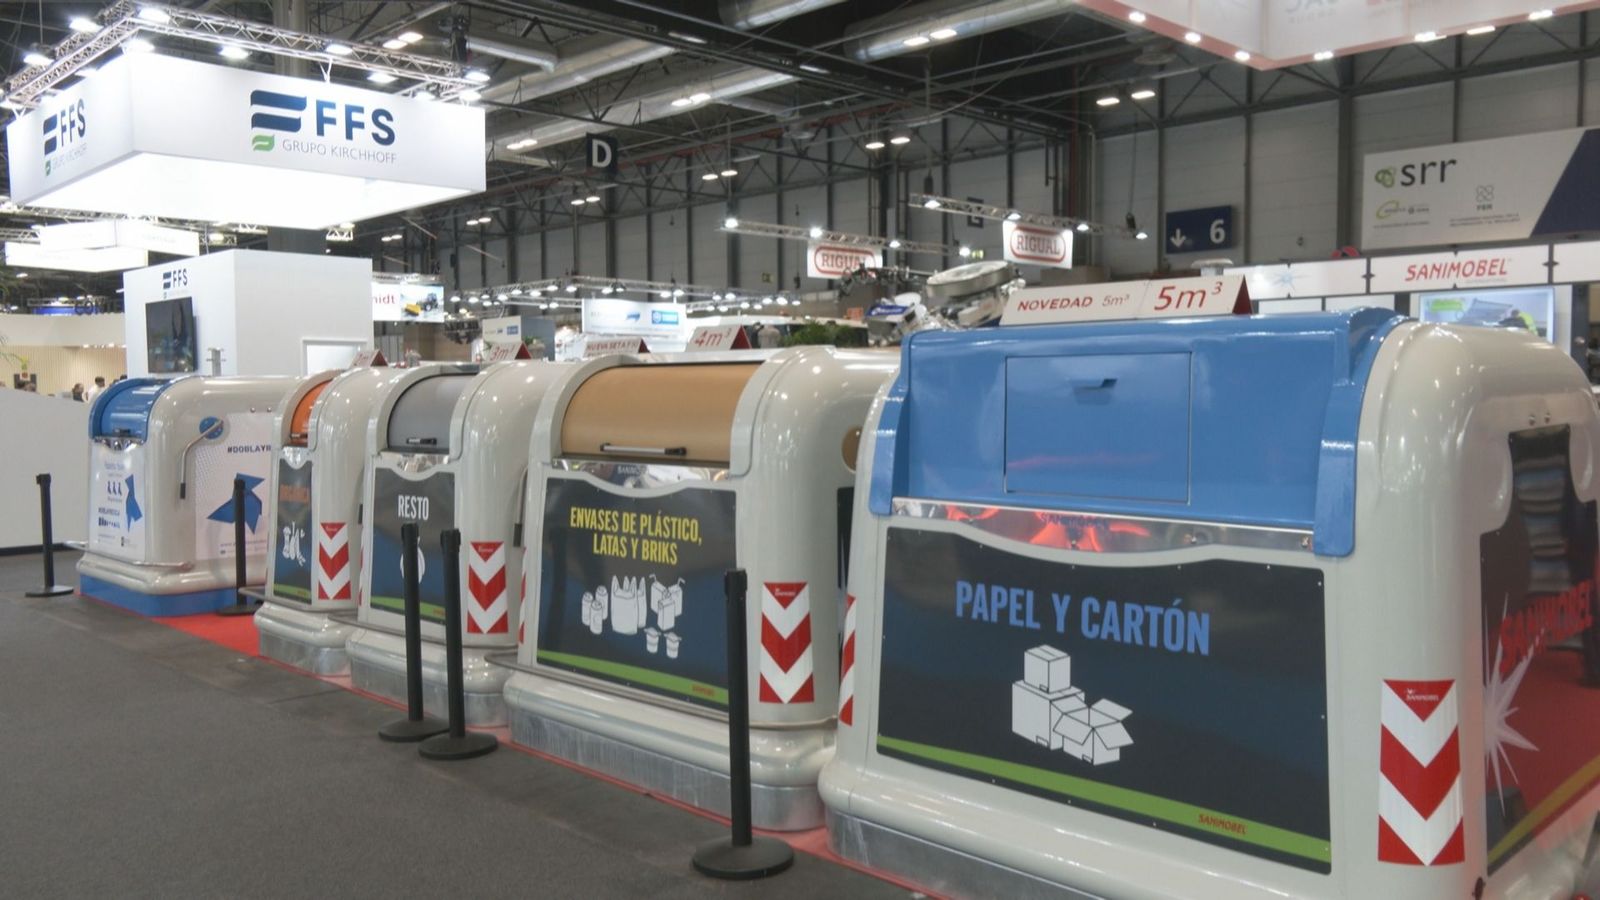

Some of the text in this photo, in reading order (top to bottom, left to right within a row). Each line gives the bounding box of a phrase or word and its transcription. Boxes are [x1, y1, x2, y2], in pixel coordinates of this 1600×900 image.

[60, 99, 86, 147] FFS
[316, 99, 395, 146] FFS
[282, 138, 397, 164] GRUPO KIRCHHOFF
[592, 138, 612, 168] D
[1401, 158, 1457, 187] srr
[1016, 234, 1060, 255] RIGUAL
[1209, 218, 1226, 244] 6
[172, 268, 188, 288] FFS
[1405, 258, 1508, 282] SANIMOBEL
[1017, 296, 1094, 312] NOVEDAD
[398, 494, 430, 521] RESTO
[570, 506, 702, 546] ENVASES DE PLÁSTICO,
[593, 533, 678, 566] LATAS Y BRIKS
[955, 580, 1210, 656] PAPEL Y CARTÓN
[1199, 813, 1247, 836] SANIMOBEL
